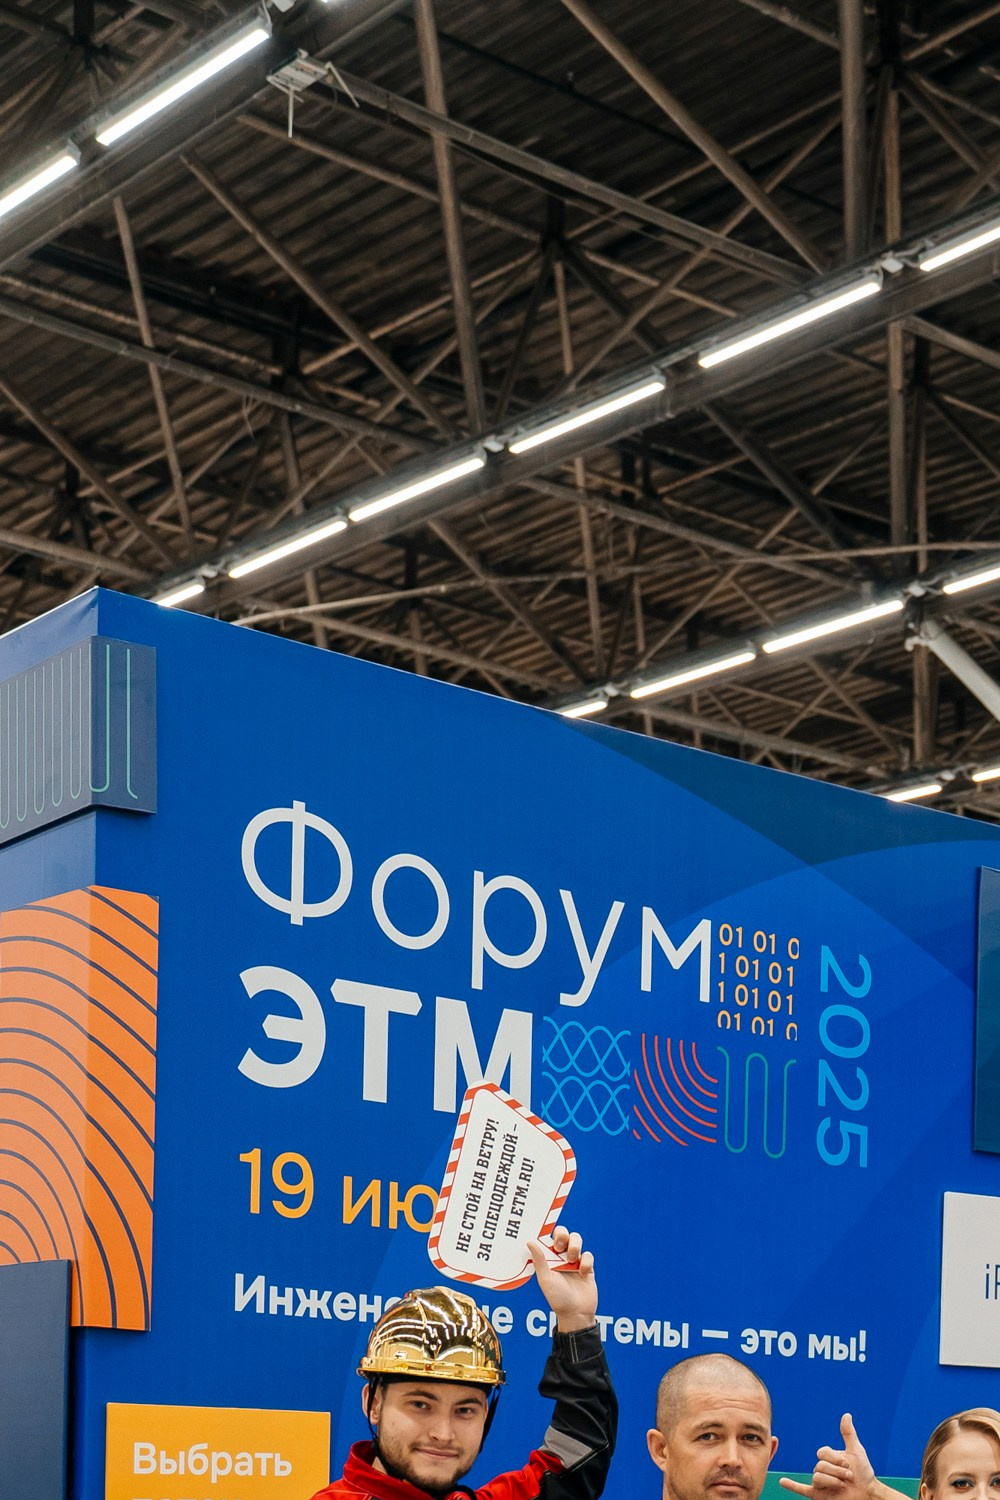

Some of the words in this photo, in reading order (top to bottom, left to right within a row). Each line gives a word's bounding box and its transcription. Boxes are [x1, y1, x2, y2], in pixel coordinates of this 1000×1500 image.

[239, 800, 713, 1007] Форум
[237, 964, 533, 1113] ЭТМ
[816, 944, 873, 1169] 2025
[476, 1118, 500, 1169] ВЕТРУ!
[239, 1147, 315, 1220] 19
[471, 1172, 487, 1191] НА
[482, 1133, 519, 1241] СПЕЦОДЕЖДОЙ
[461, 1192, 482, 1231] СТОЙ
[505, 1221, 521, 1240] НА
[455, 1232, 472, 1253] НЕ
[477, 1242, 493, 1262] ЗА
[740, 1328, 798, 1358] это
[807, 1329, 868, 1363] мы!
[133, 1441, 293, 1484] Выбрать
